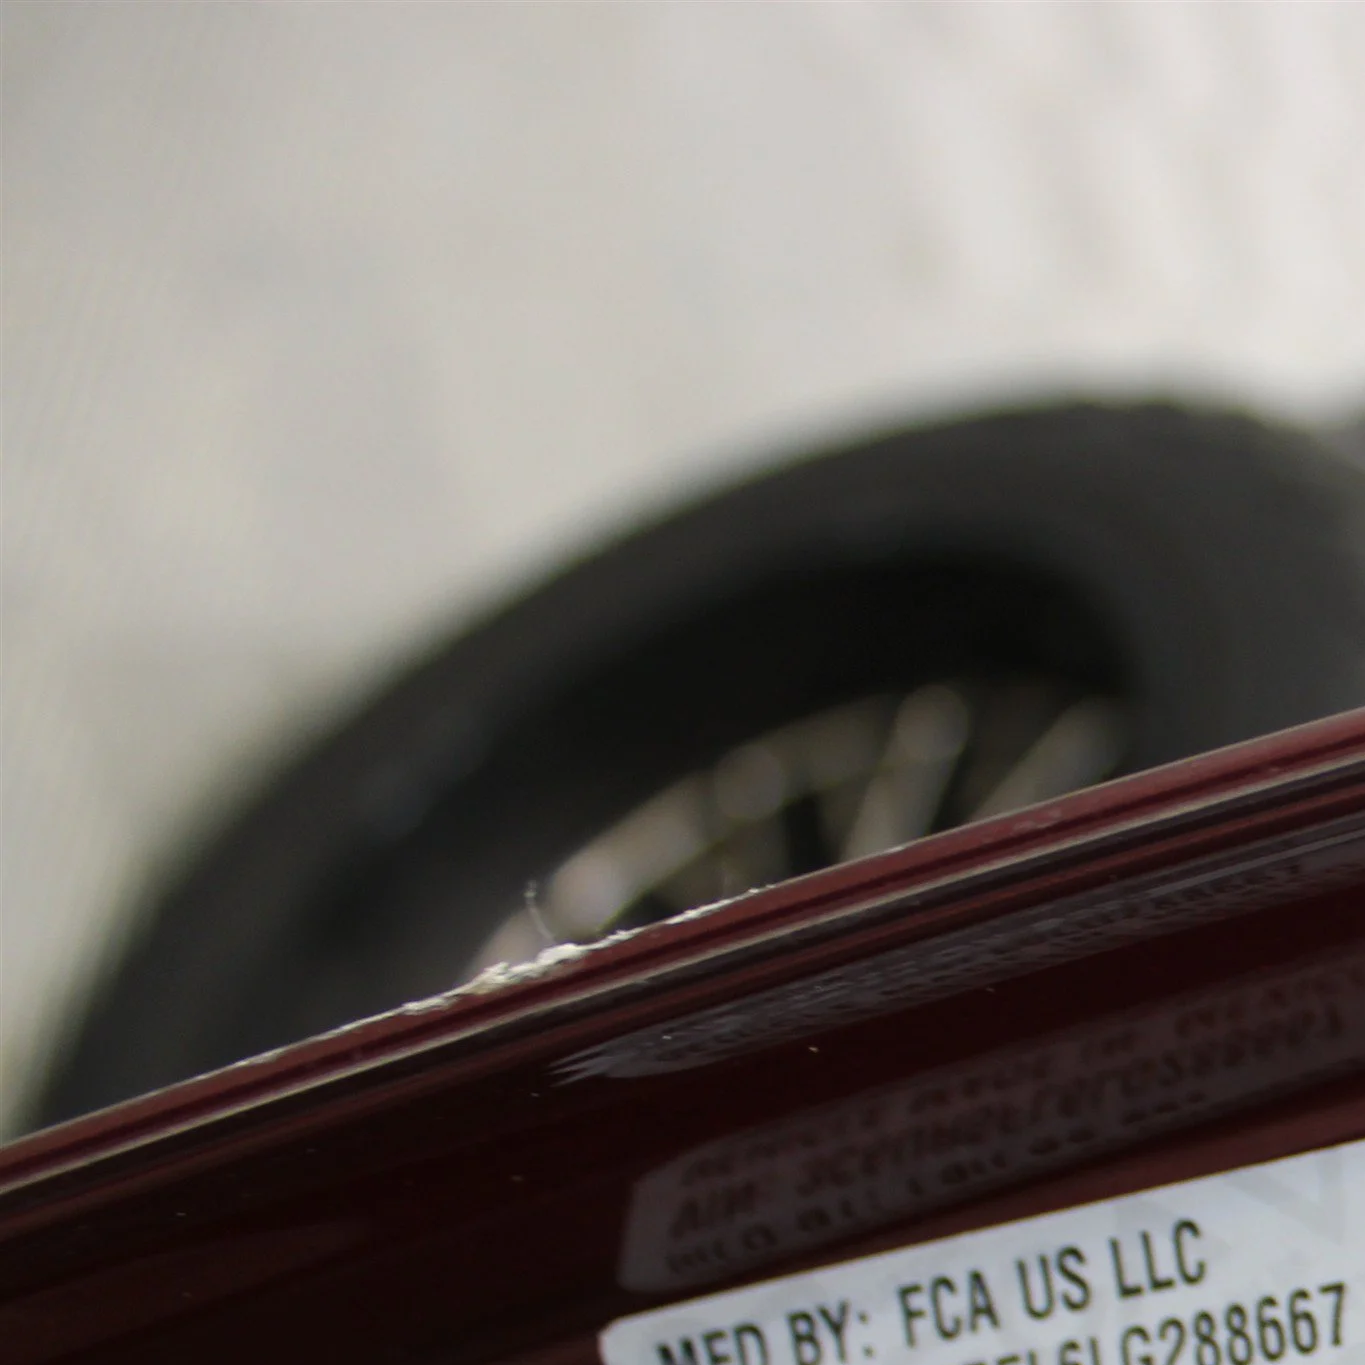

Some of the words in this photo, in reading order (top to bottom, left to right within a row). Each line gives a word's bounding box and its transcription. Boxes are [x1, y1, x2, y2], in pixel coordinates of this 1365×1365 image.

[897, 1270, 1000, 1348] FCA
[1016, 1246, 1092, 1320] US
[1109, 1219, 1206, 1300] LLC
